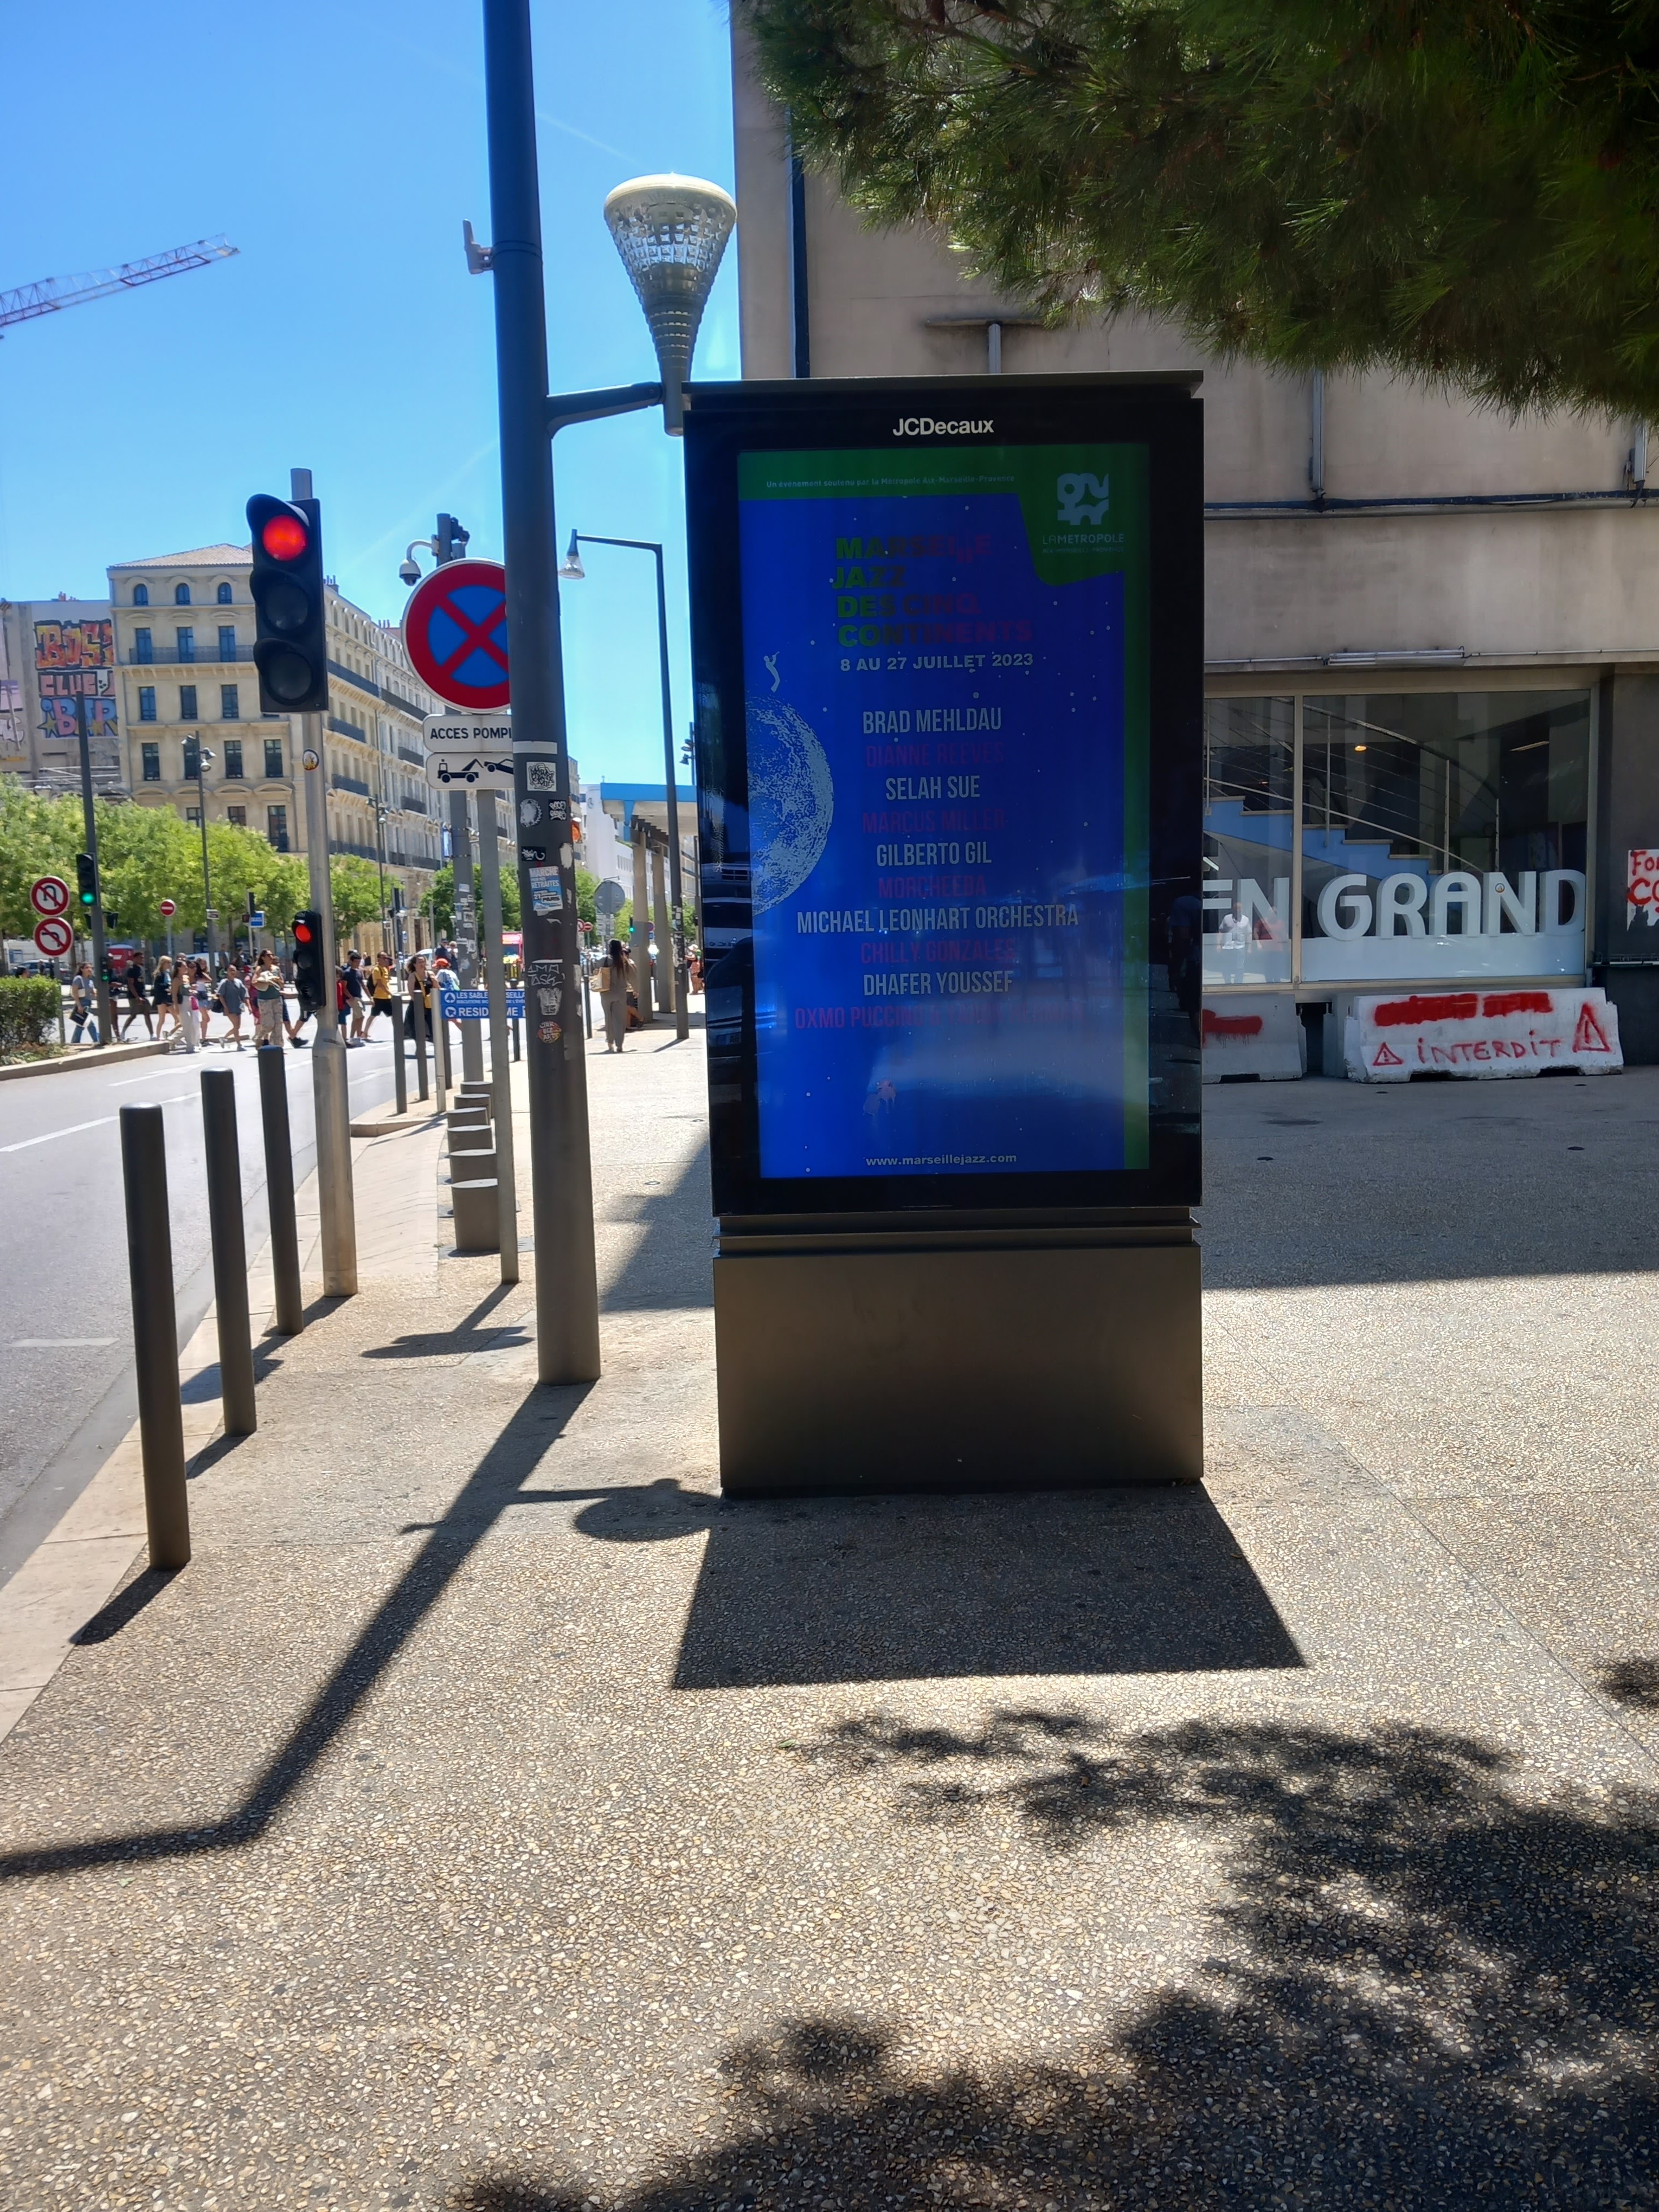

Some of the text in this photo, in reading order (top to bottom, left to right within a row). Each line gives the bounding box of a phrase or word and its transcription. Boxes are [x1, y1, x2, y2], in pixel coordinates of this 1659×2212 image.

[892, 417, 994, 436] JCDecaux
[832, 566, 907, 589] JAZZ
[837, 593, 982, 618] DES CINQ
[838, 620, 1033, 647] CONTINENTS
[840, 653, 1033, 671] 8 AU 27 JUILLET 2023
[430, 727, 512, 740] ACCES POMPI
[863, 708, 1002, 734] BRAD MEHLDAU
[866, 741, 1005, 768] DIANNE REEVES
[886, 775, 980, 800] SELAH SUE
[862, 808, 1006, 833] MARCUS MILLER
[876, 841, 992, 867] GILBERTO GIL
[878, 875, 987, 899] MORCHEEBA
[1317, 869, 1585, 941] GRAND
[797, 904, 1079, 934] MICHAEL LEONHART ORCHESTRA
[861, 938, 1016, 964] CHILLY GONZALES
[864, 970, 1013, 996] DHAFER YOUSSEF
[795, 1007, 845, 1029] OXMO
[850, 1006, 923, 1027] PUCCINO
[866, 1153, 1017, 1166] www.marseillejazz.com
